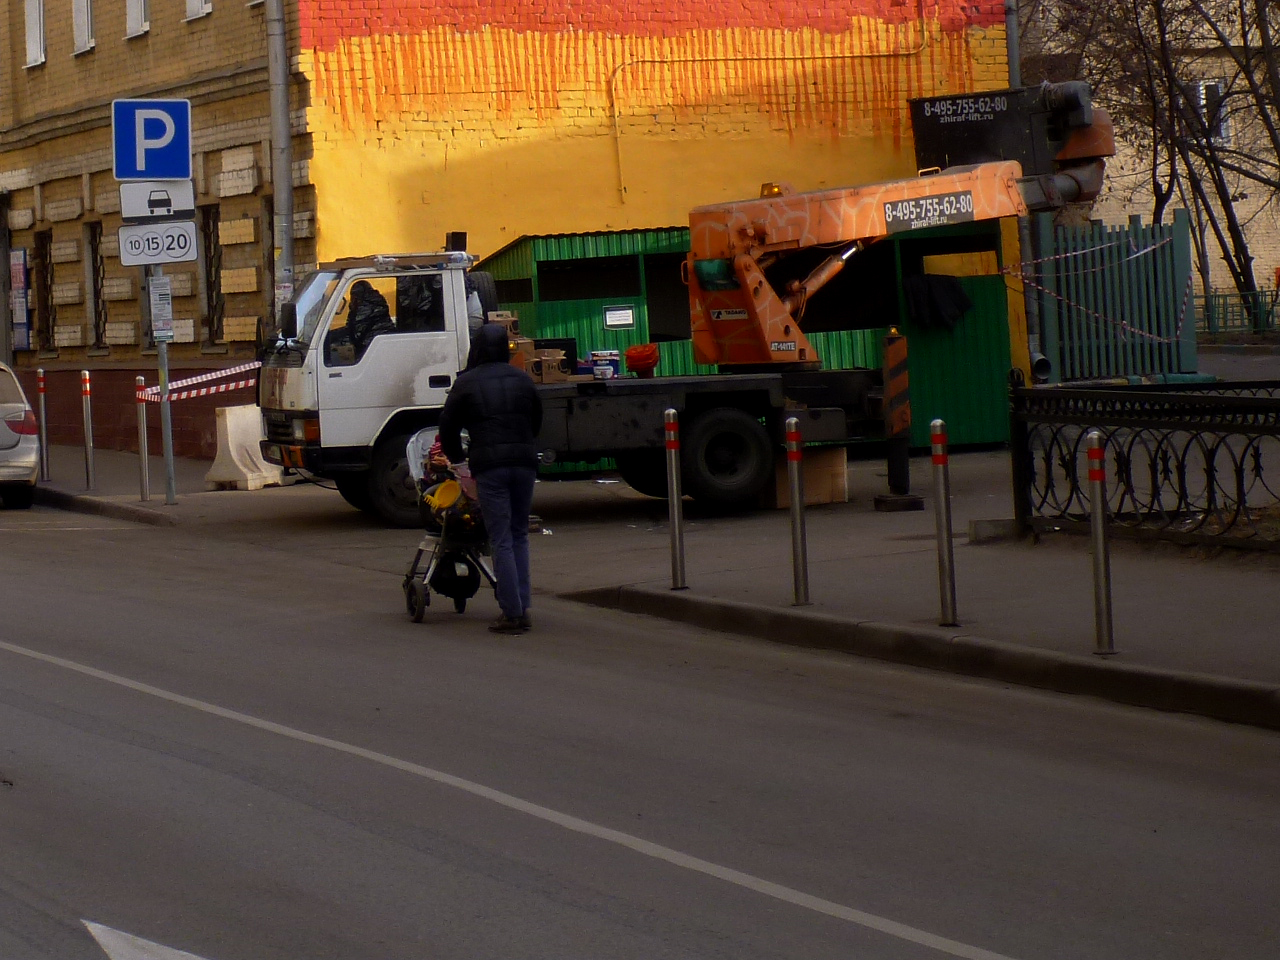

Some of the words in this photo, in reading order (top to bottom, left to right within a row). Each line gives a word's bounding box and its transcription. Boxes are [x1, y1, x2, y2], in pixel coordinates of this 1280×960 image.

[924, 96, 1008, 117] 8-495-755-62-80
[940, 112, 994, 124] zhiraf-lift.ru
[135, 109, 176, 171] P
[885, 194, 973, 222] 8-495-755-62-80
[911, 215, 948, 229] zhiraf-lift.ru
[128, 240, 141, 251] 10
[145, 236, 160, 251] 15
[165, 233, 188, 251] 20
